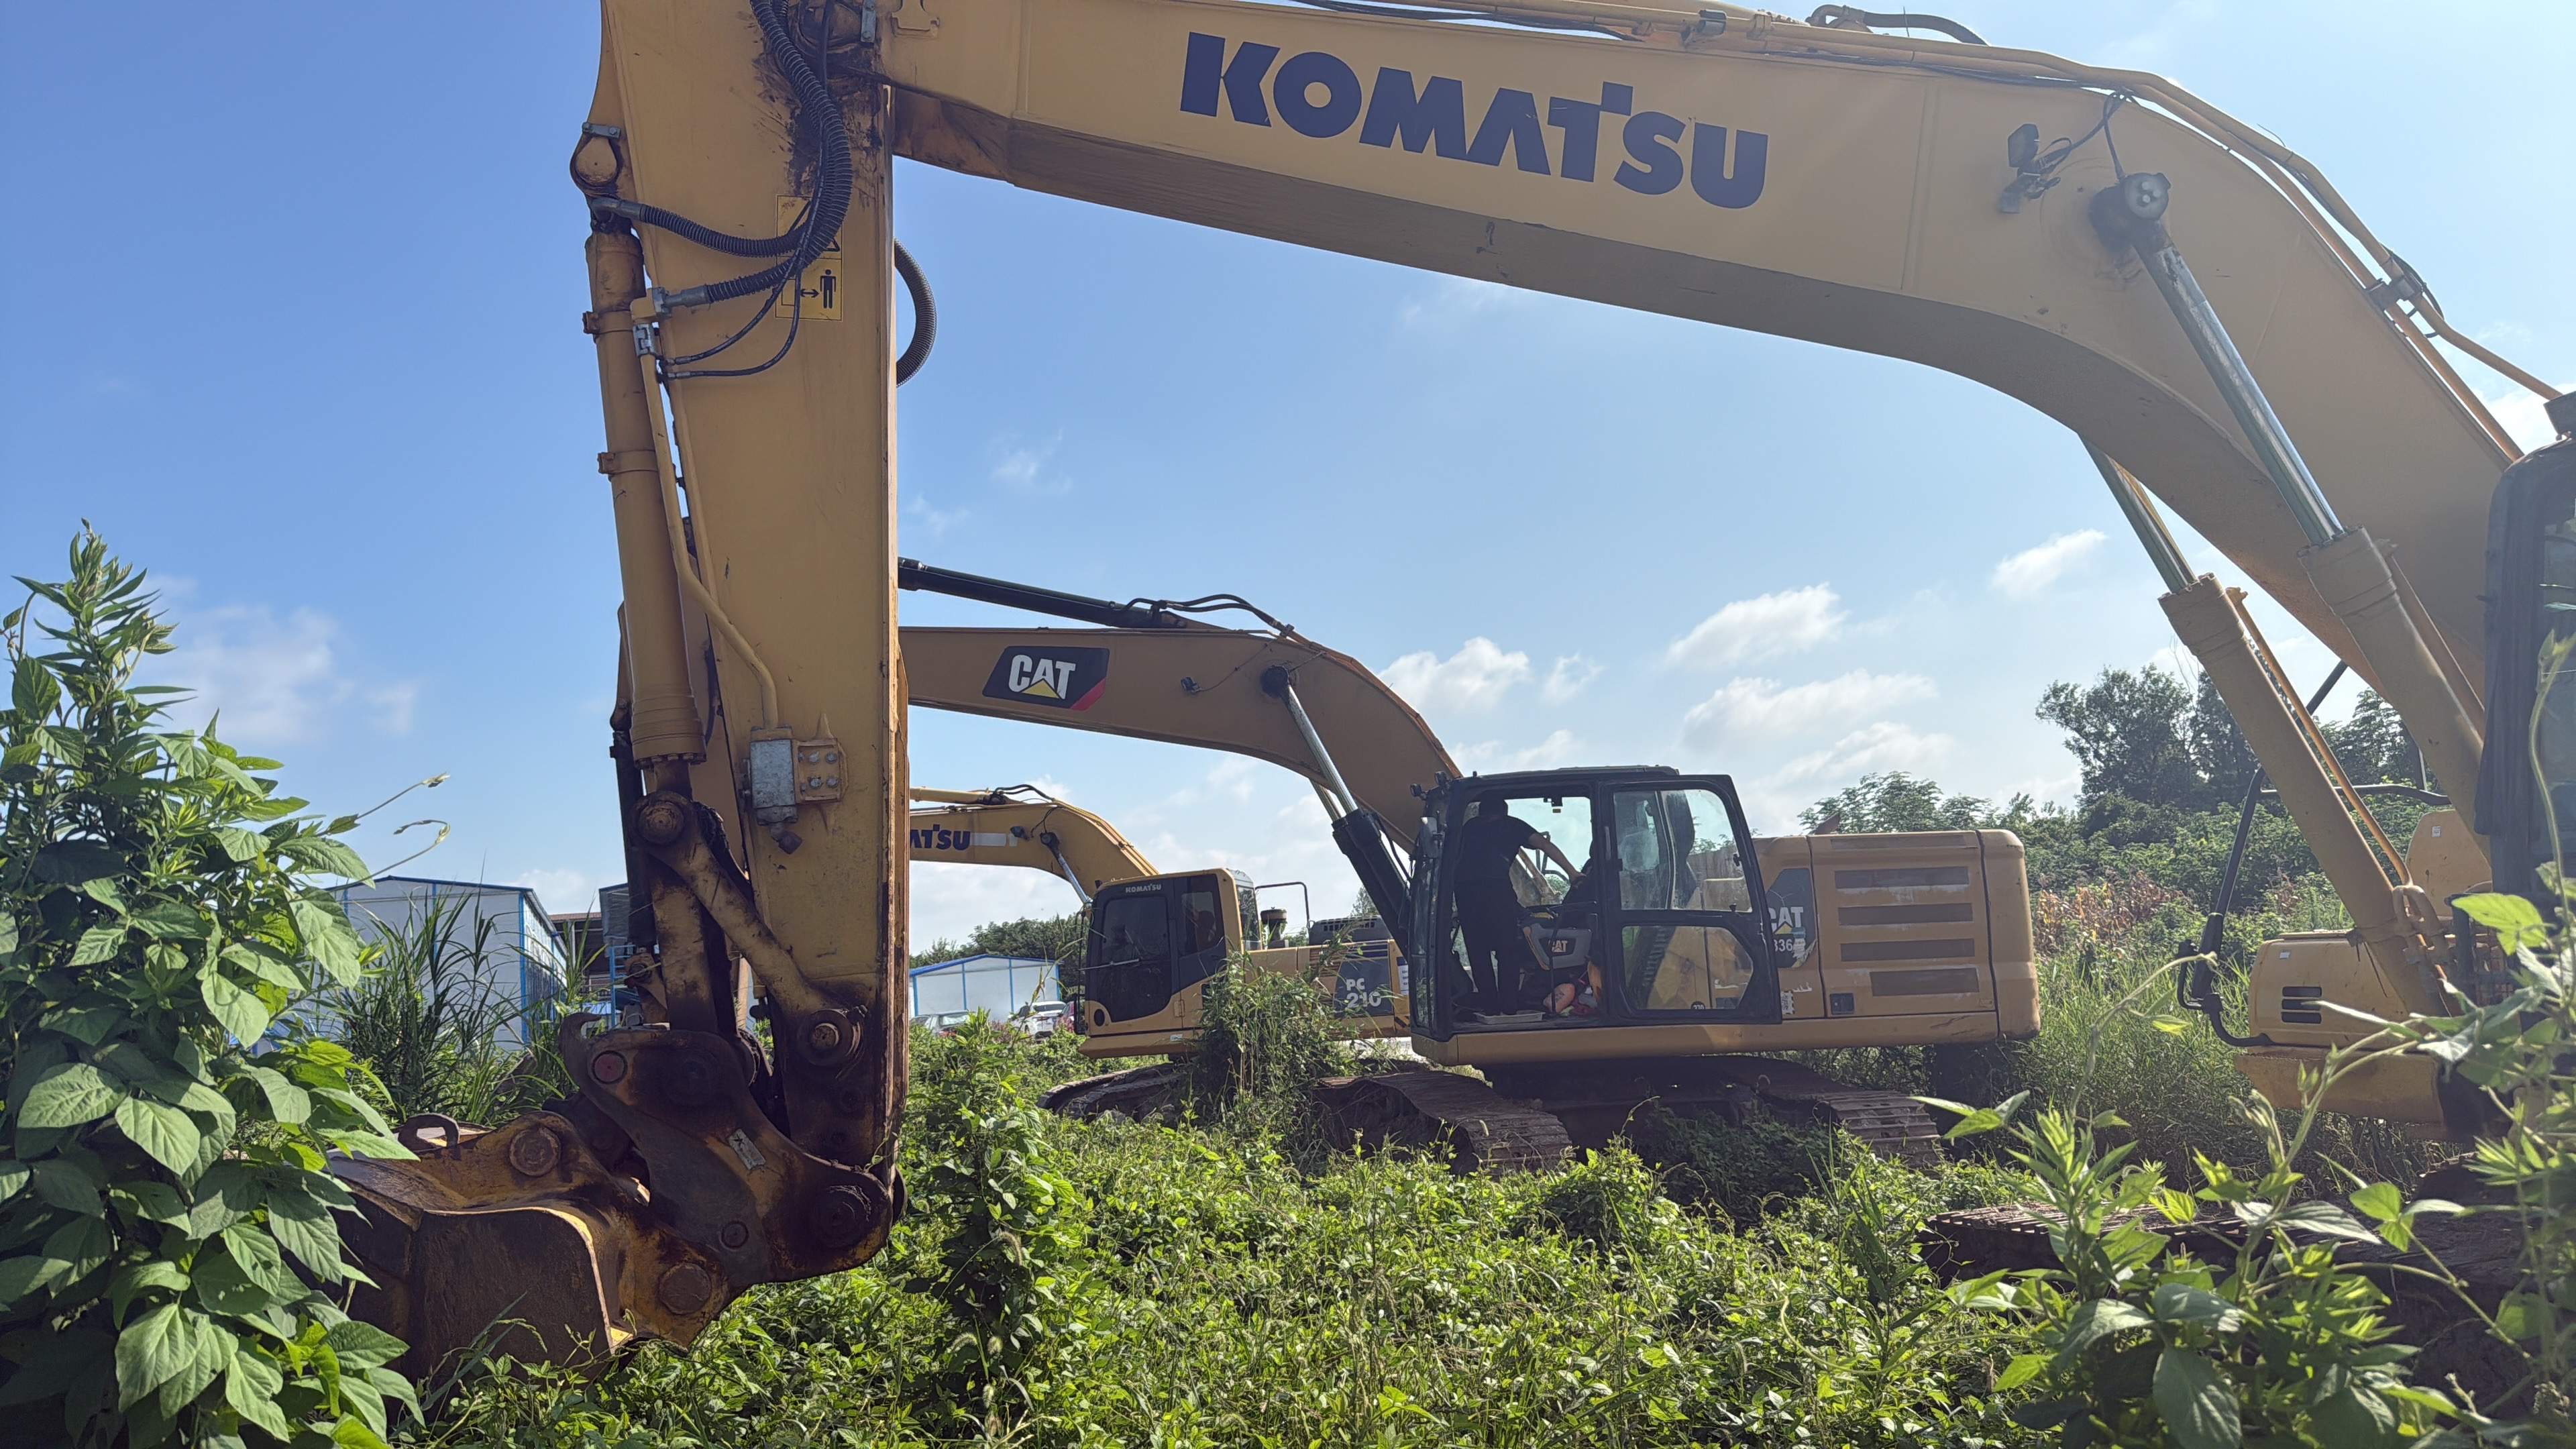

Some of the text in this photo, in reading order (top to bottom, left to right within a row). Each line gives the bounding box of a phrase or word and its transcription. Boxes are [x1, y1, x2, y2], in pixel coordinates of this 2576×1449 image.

[1179, 32, 1769, 209] KOMATSU
[1008, 654, 1076, 700] CAT
[910, 824, 971, 851] ATSU
[1125, 883, 1162, 893] KOMATSU
[1346, 978, 1365, 991] PC
[1346, 991, 1382, 1008] 210
